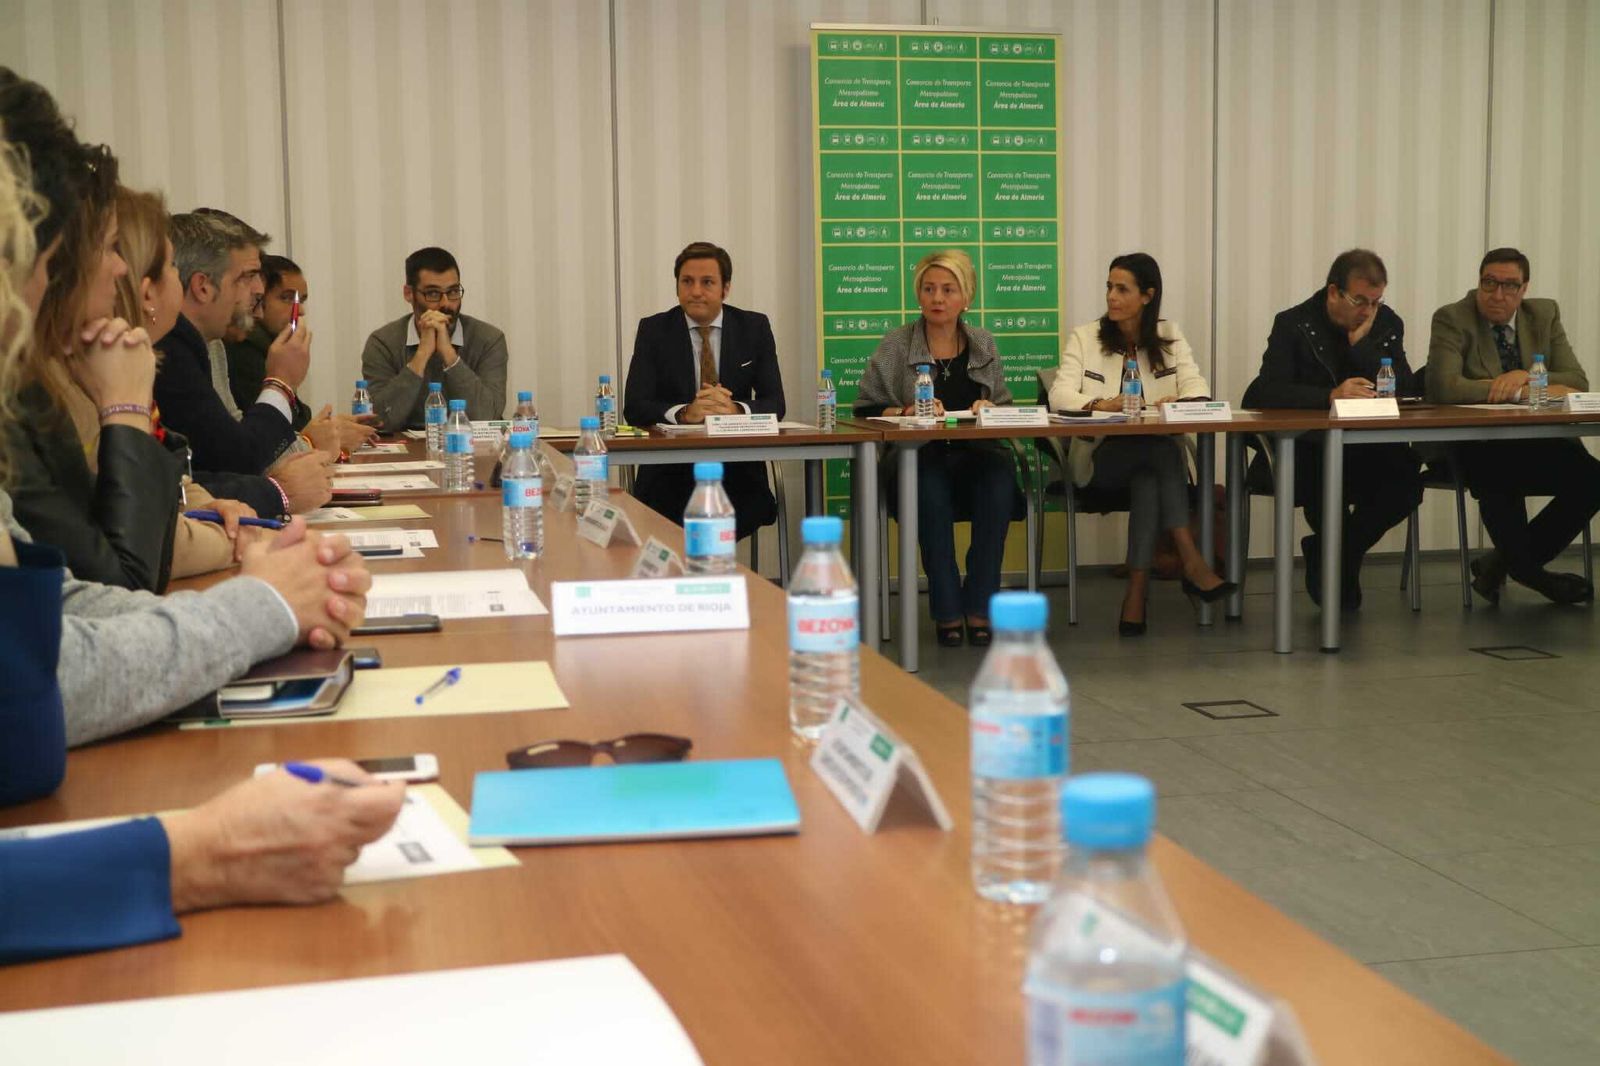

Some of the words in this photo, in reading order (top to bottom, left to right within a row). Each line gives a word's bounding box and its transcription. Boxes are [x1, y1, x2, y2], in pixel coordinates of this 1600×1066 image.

[571, 604, 675, 615] AYUNTAMIENTO
[678, 603, 695, 613] DE
[698, 602, 732, 613] RIOJA
